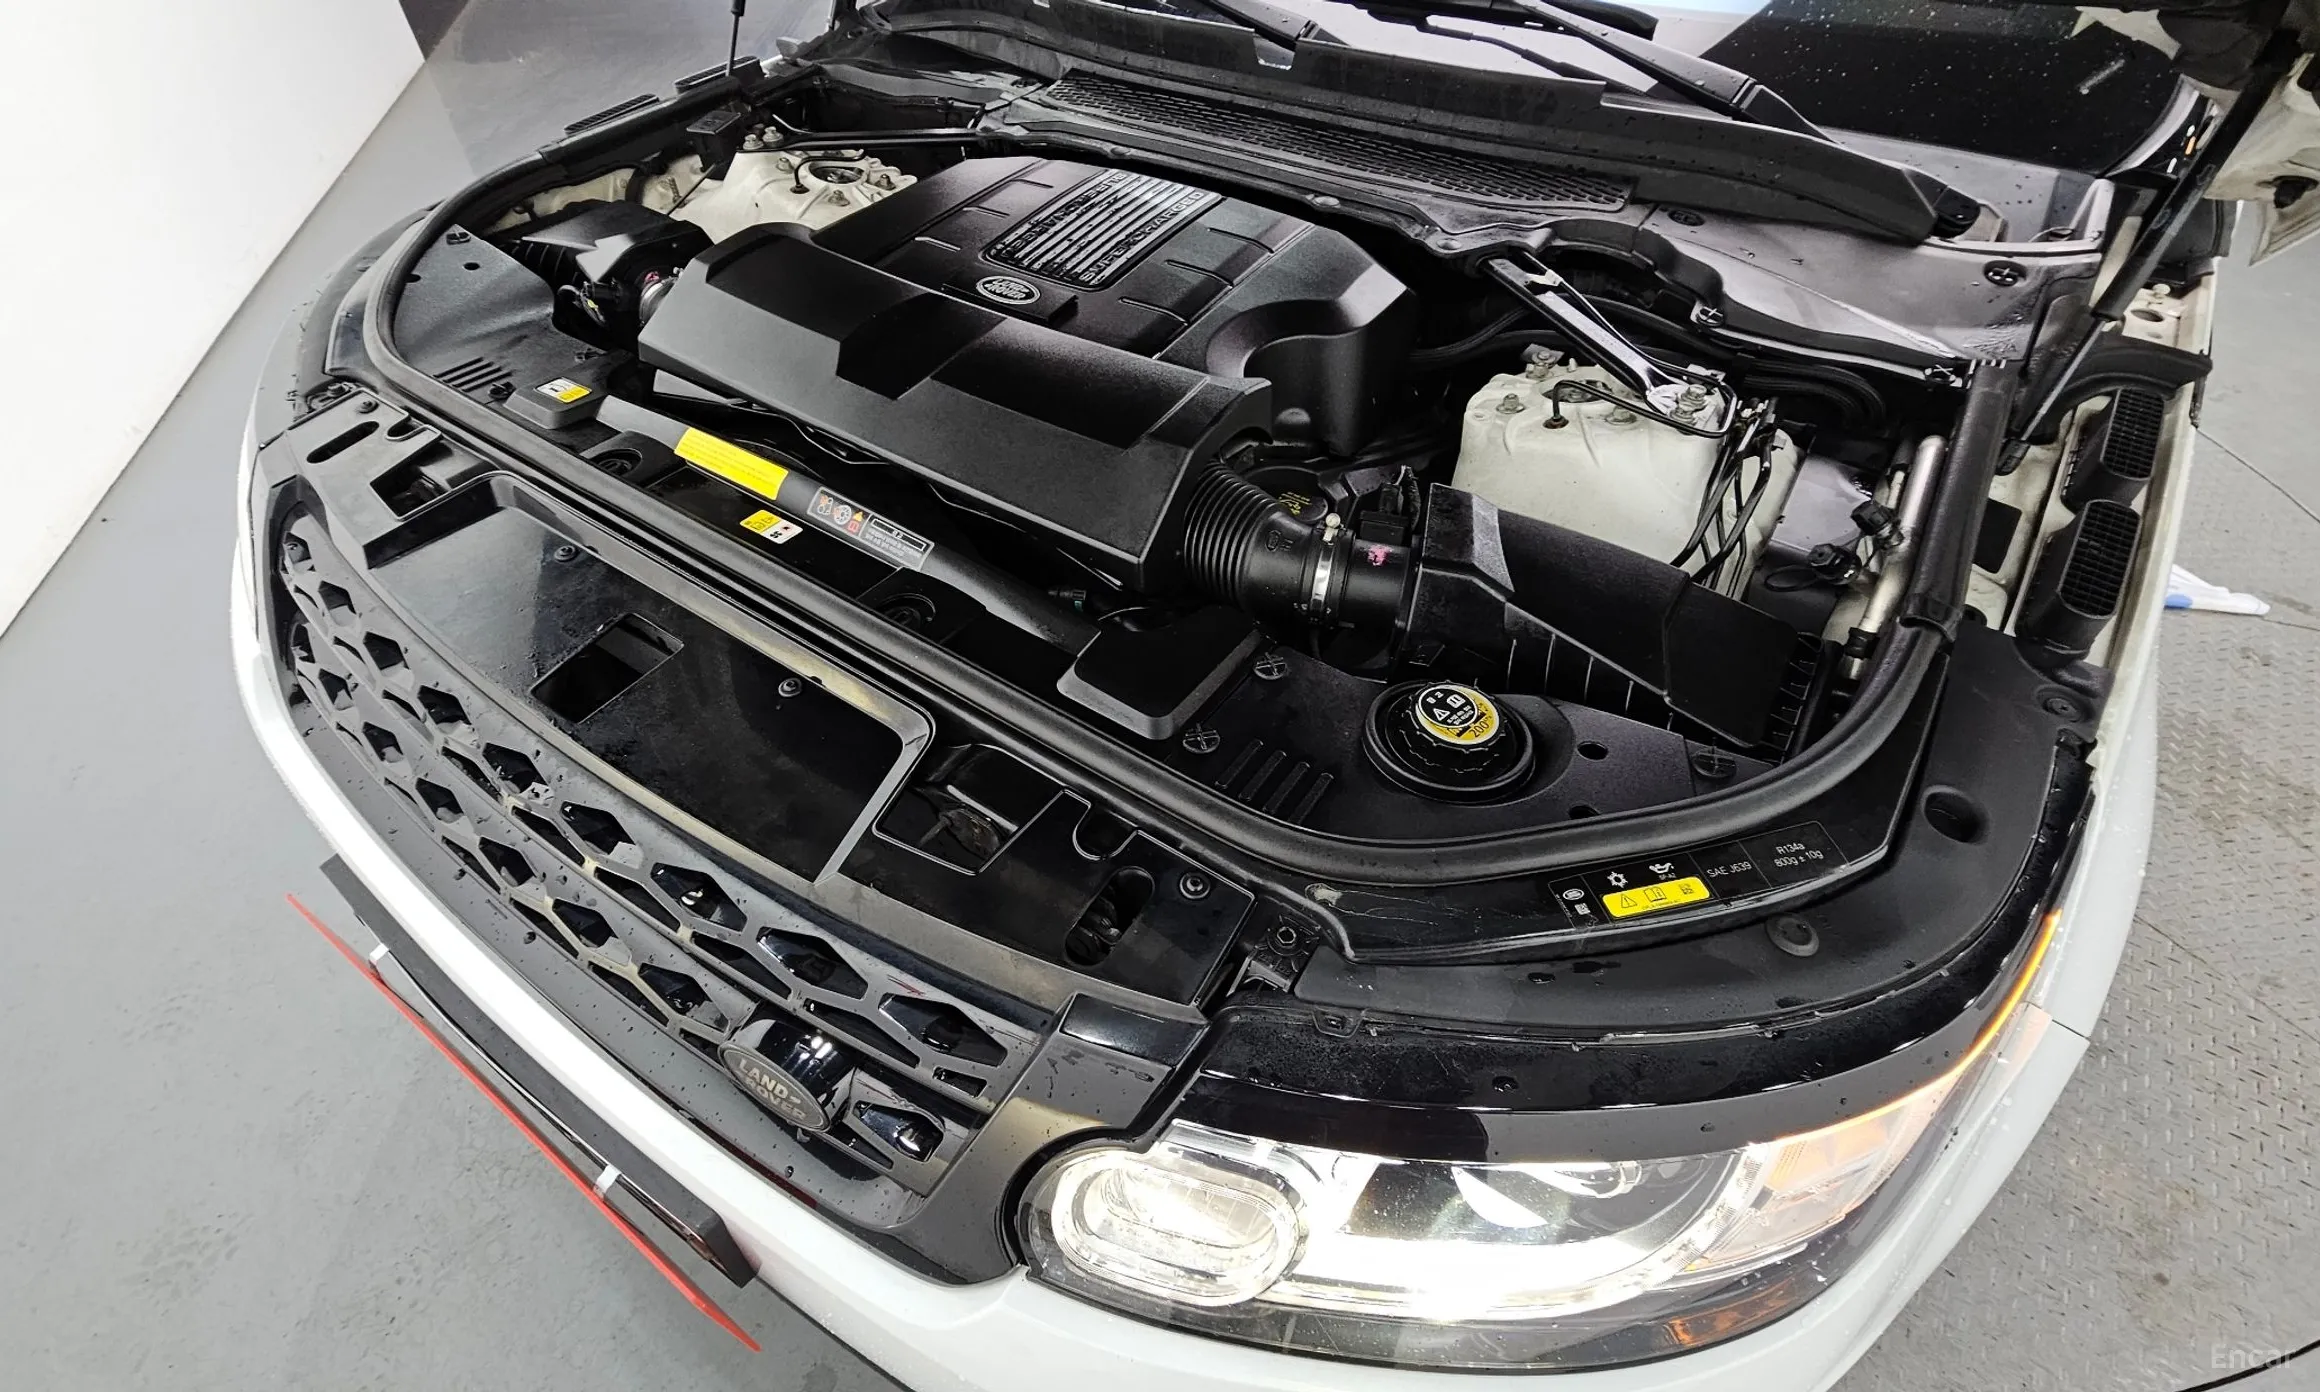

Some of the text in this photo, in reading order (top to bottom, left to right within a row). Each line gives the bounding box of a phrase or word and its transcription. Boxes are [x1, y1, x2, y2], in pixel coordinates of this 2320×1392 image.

[1775, 842, 1806, 855] R134a
[1773, 856, 1798, 868] 800g
[1805, 850, 1825, 860] 10g
[1706, 861, 1752, 878] SAE J639
[739, 1059, 789, 1099] LAND
[745, 1078, 807, 1121] ROVER
